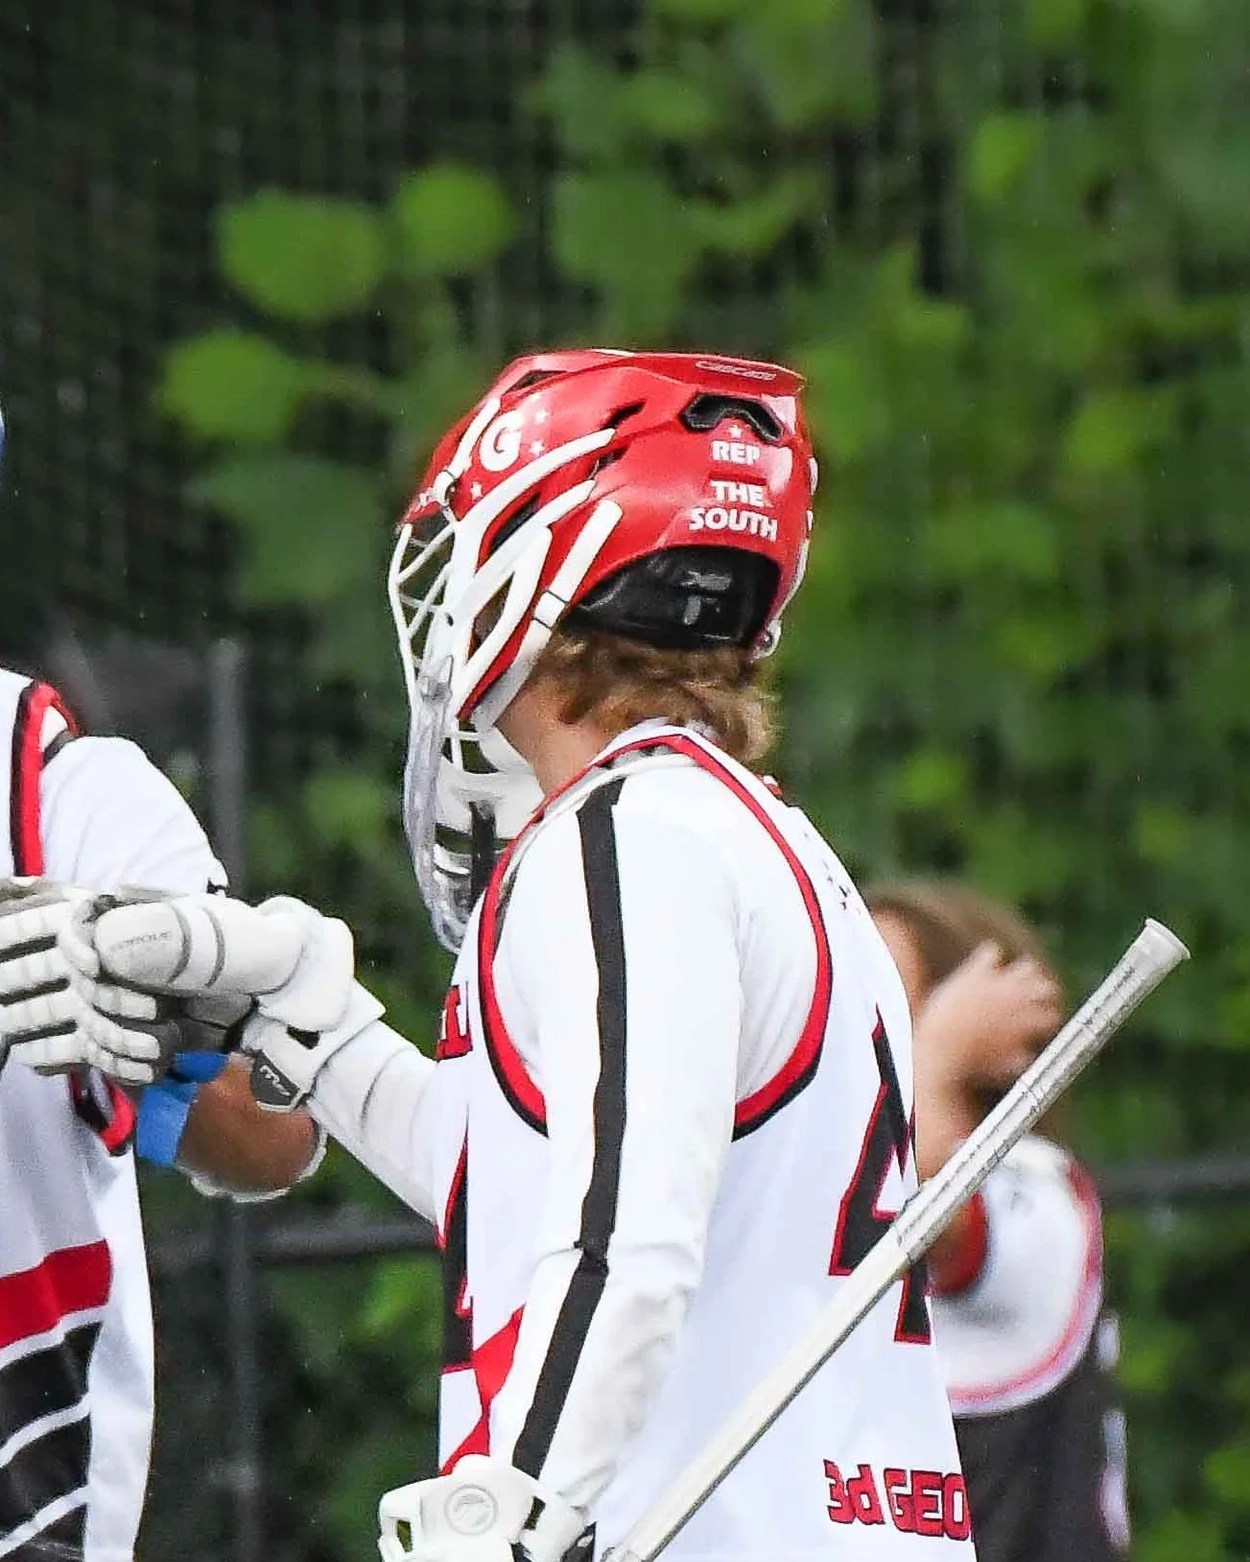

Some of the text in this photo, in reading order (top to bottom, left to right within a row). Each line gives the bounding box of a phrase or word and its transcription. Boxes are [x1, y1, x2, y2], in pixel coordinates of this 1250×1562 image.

[479, 408, 524, 472] G
[711, 439, 761, 466] REP
[709, 479, 766, 508] THE
[688, 506, 778, 542] SOUTH
[823, 1458, 886, 1525] 3d
